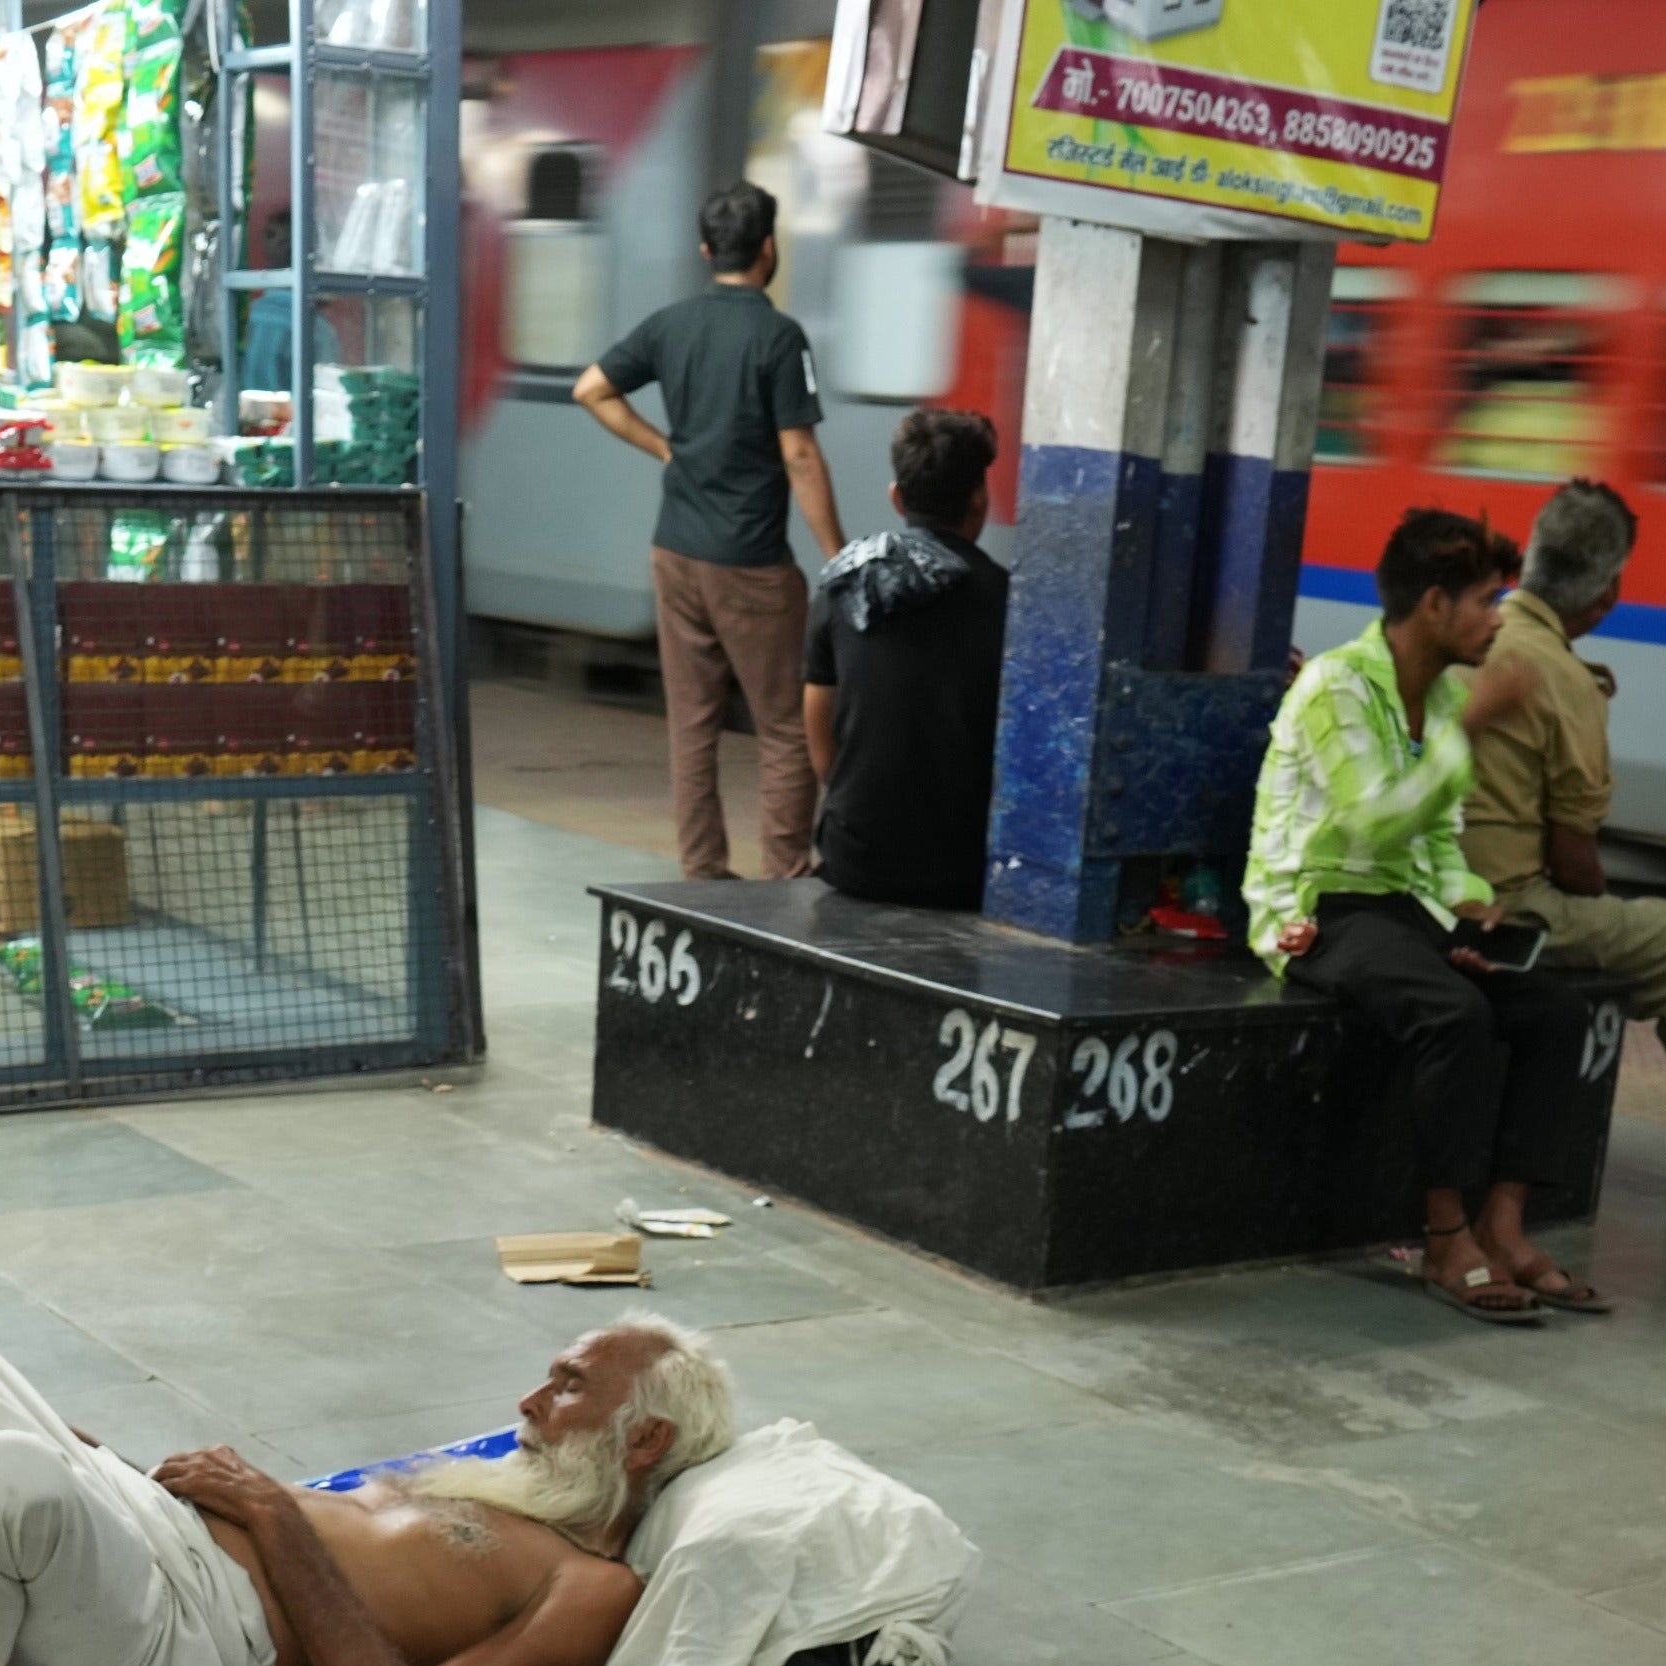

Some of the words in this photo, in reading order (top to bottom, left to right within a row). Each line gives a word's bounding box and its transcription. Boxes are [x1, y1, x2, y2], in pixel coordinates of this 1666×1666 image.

[1117, 78, 1277, 144] 7007504263,
[1283, 109, 1437, 170] 8858090925
[607, 909, 702, 1007] 266
[933, 1008, 1038, 1123] 267
[1063, 1029, 1178, 1130] 268
